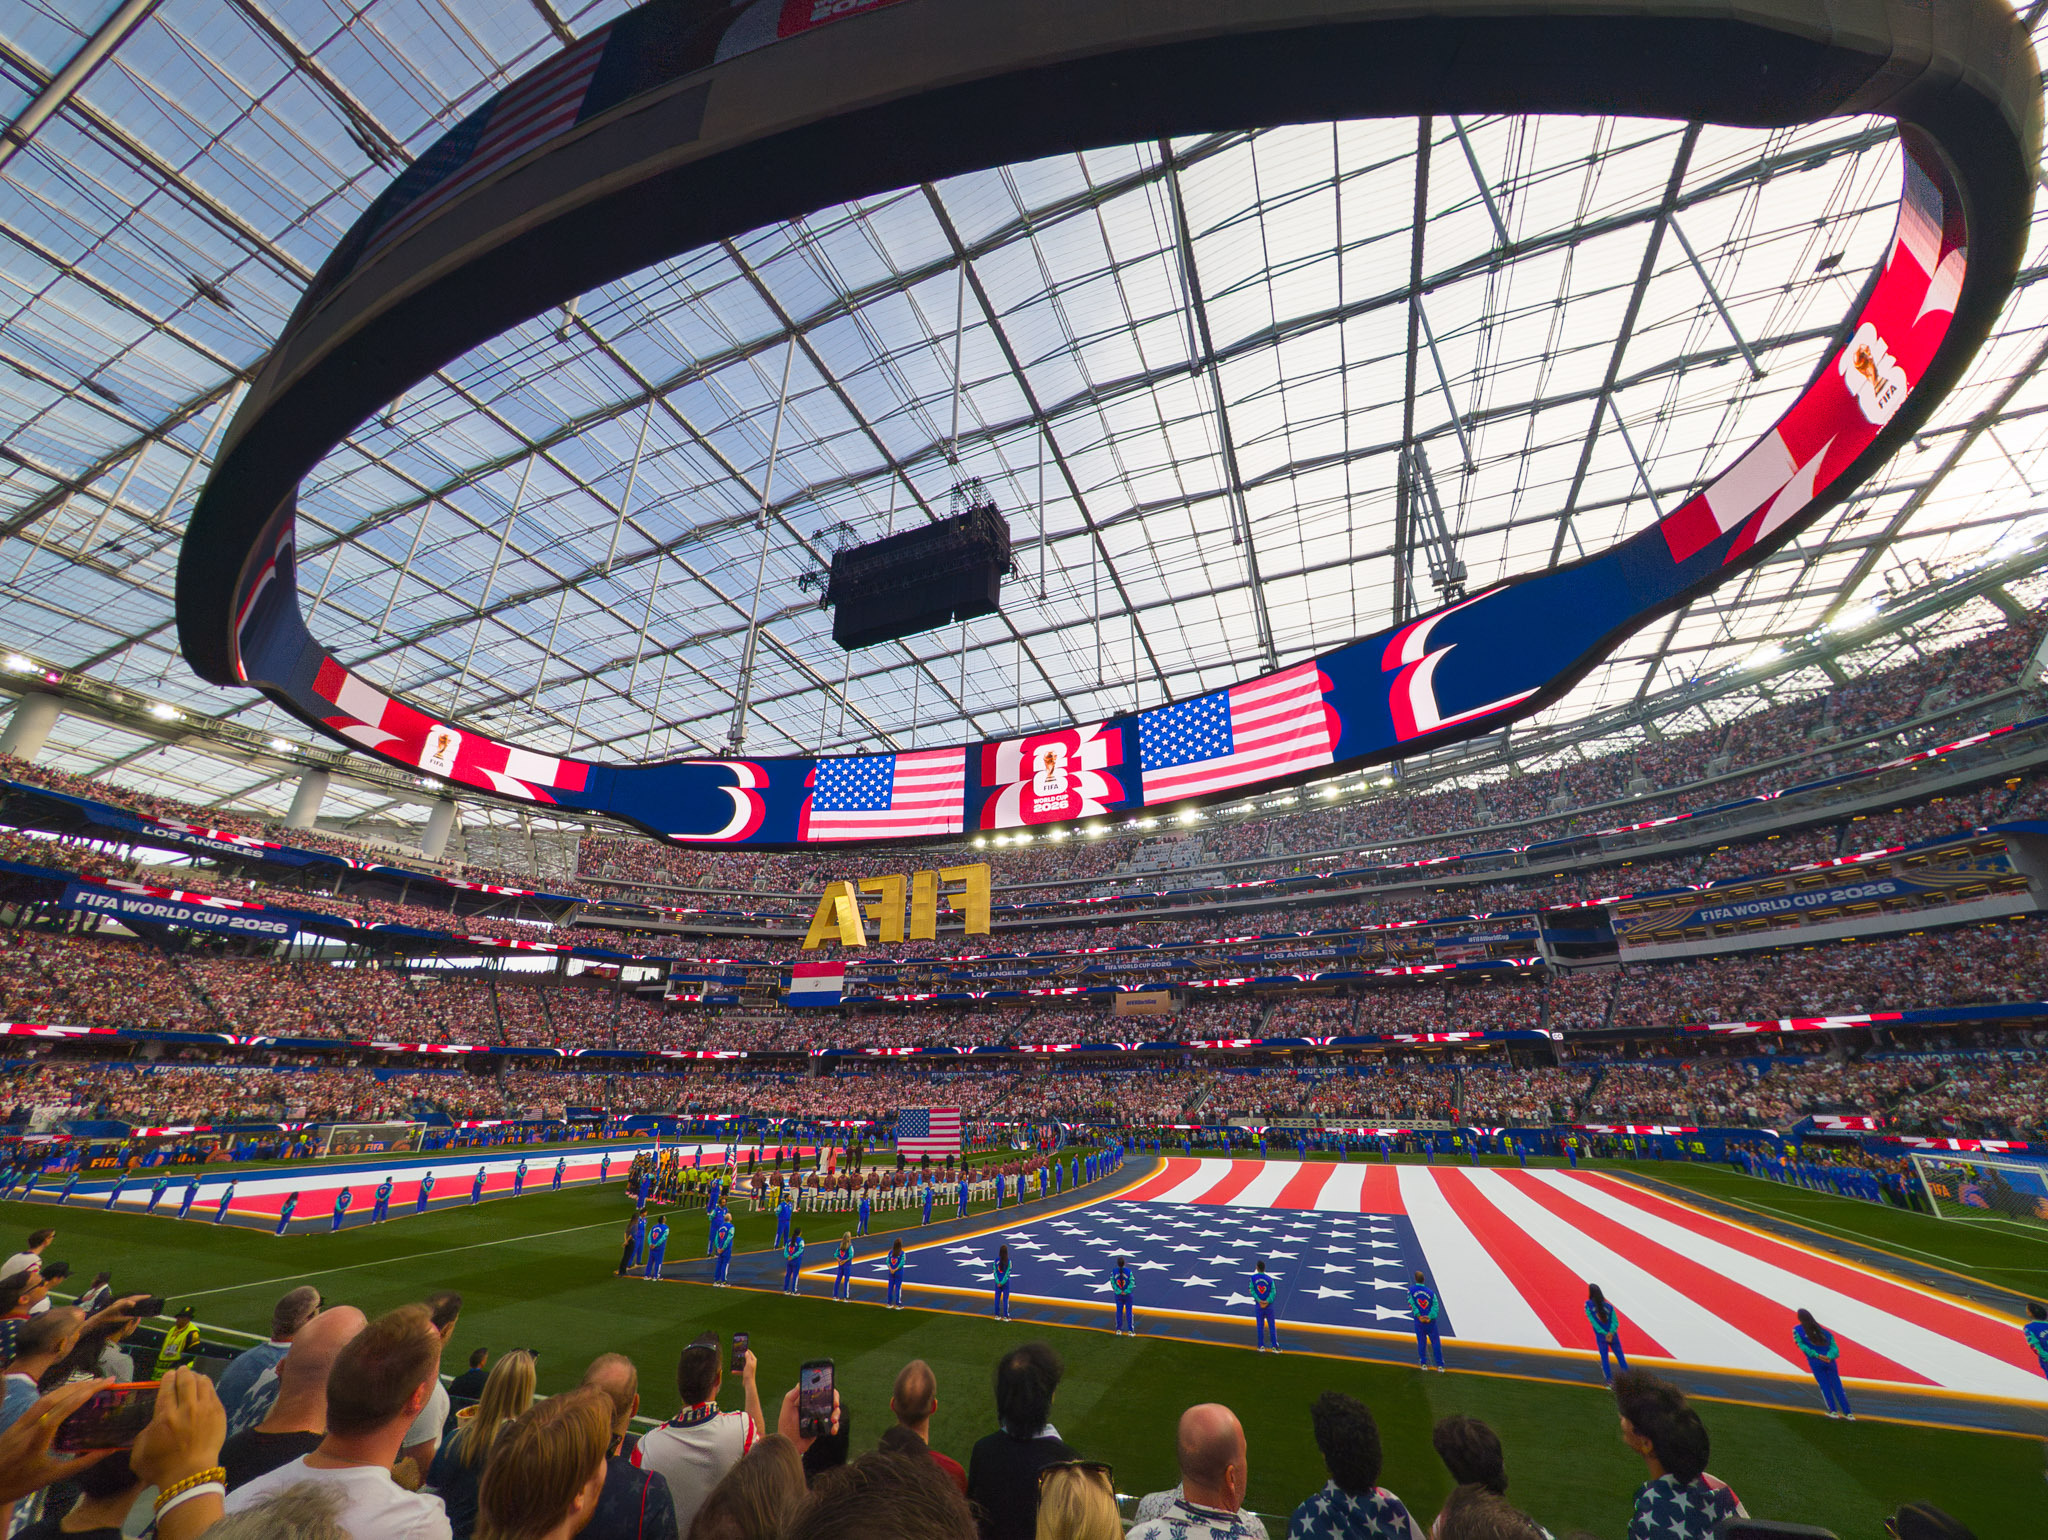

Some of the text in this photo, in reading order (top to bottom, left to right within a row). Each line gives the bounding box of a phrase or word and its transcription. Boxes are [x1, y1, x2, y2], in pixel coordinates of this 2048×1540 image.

[1878, 384, 1897, 409] FIFA
[429, 758, 444, 768] FIFA
[1043, 783, 1059, 791] FIFA
[1033, 796, 1056, 804] WORLD
[1033, 800, 1069, 813] 2026
[142, 826, 264, 858] LOS ANGELES
[1700, 881, 1896, 922] FIFA WORLD CUP 2026
[74, 891, 289, 934] FIFA WORLD CUP 2026
[1263, 949, 1337, 960] LOS ANGELES
[364, 1143, 385, 1151] FIFA
